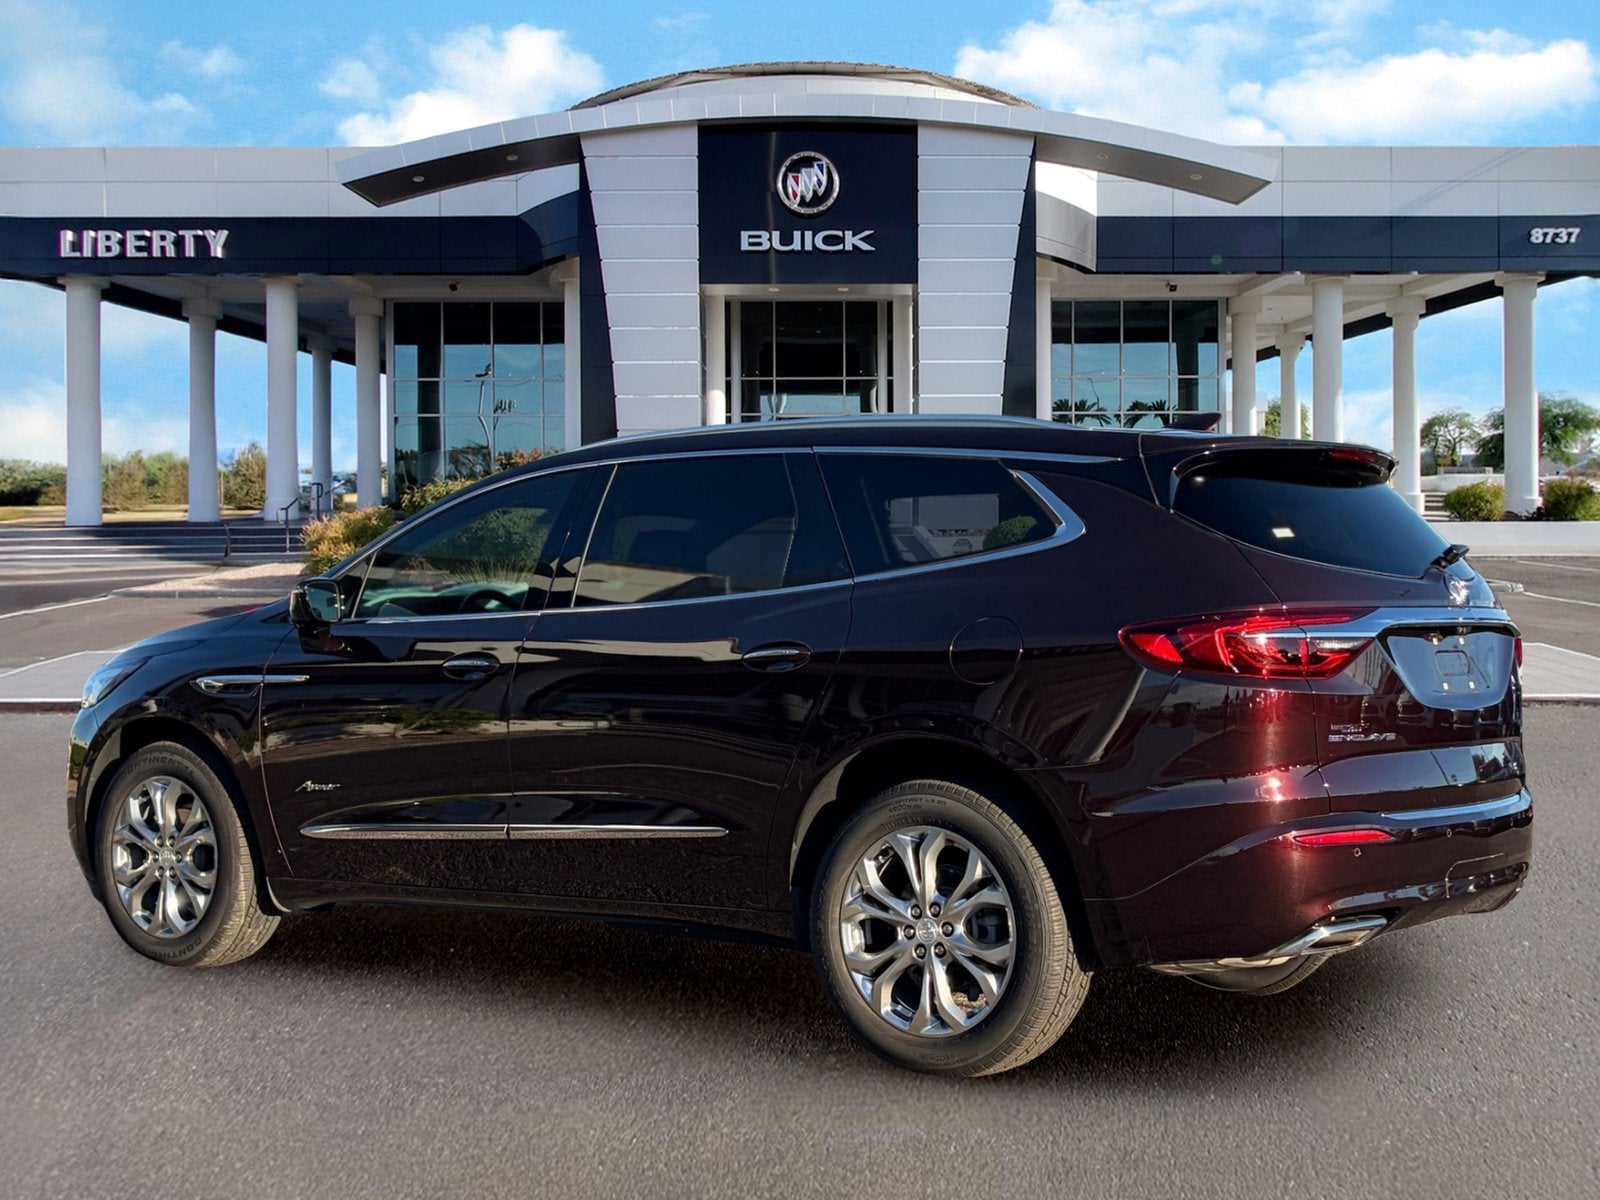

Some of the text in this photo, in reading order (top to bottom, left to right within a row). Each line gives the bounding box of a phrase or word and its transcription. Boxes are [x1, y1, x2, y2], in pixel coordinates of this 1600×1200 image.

[59, 229, 229, 258] LIBERTY
[740, 230, 876, 251] BUICK
[1529, 227, 1581, 244] 8737
